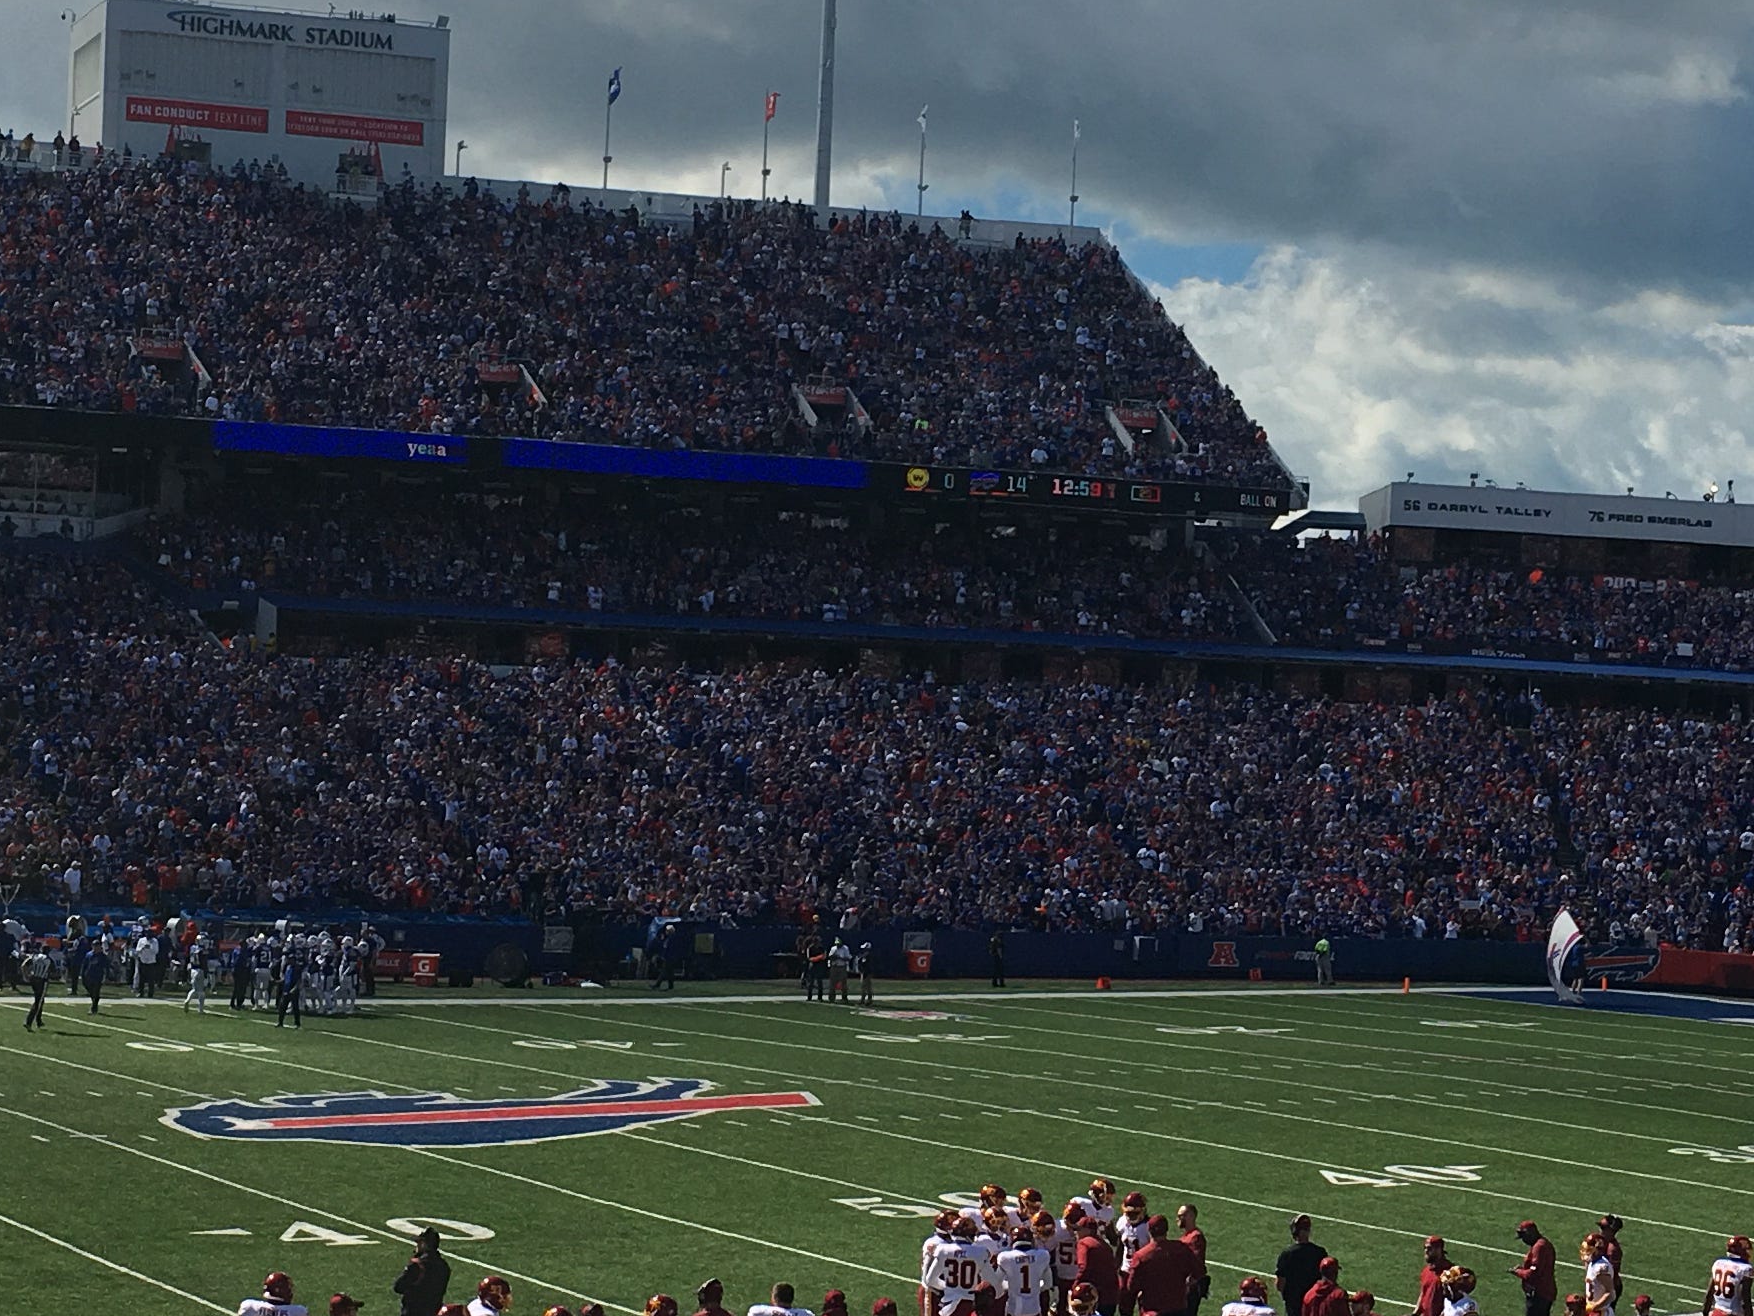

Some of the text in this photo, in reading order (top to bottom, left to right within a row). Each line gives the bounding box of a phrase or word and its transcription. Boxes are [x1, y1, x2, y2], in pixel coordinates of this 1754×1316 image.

[178, 13, 394, 51] HIGHMARK STADIUM
[130, 103, 264, 128] FAN CONDUCT TEXT LINE
[407, 439, 447, 457] yeaa
[945, 474, 1101, 496] 0 14 12:59
[1240, 493, 1277, 508] BALL ON
[1403, 499, 1552, 518] 56 DARRYL TALLEY
[1588, 510, 1605, 522] 76
[1608, 513, 1644, 523] FRED
[944, 1259, 977, 1290] 30
[1020, 1264, 1032, 1295] 1
